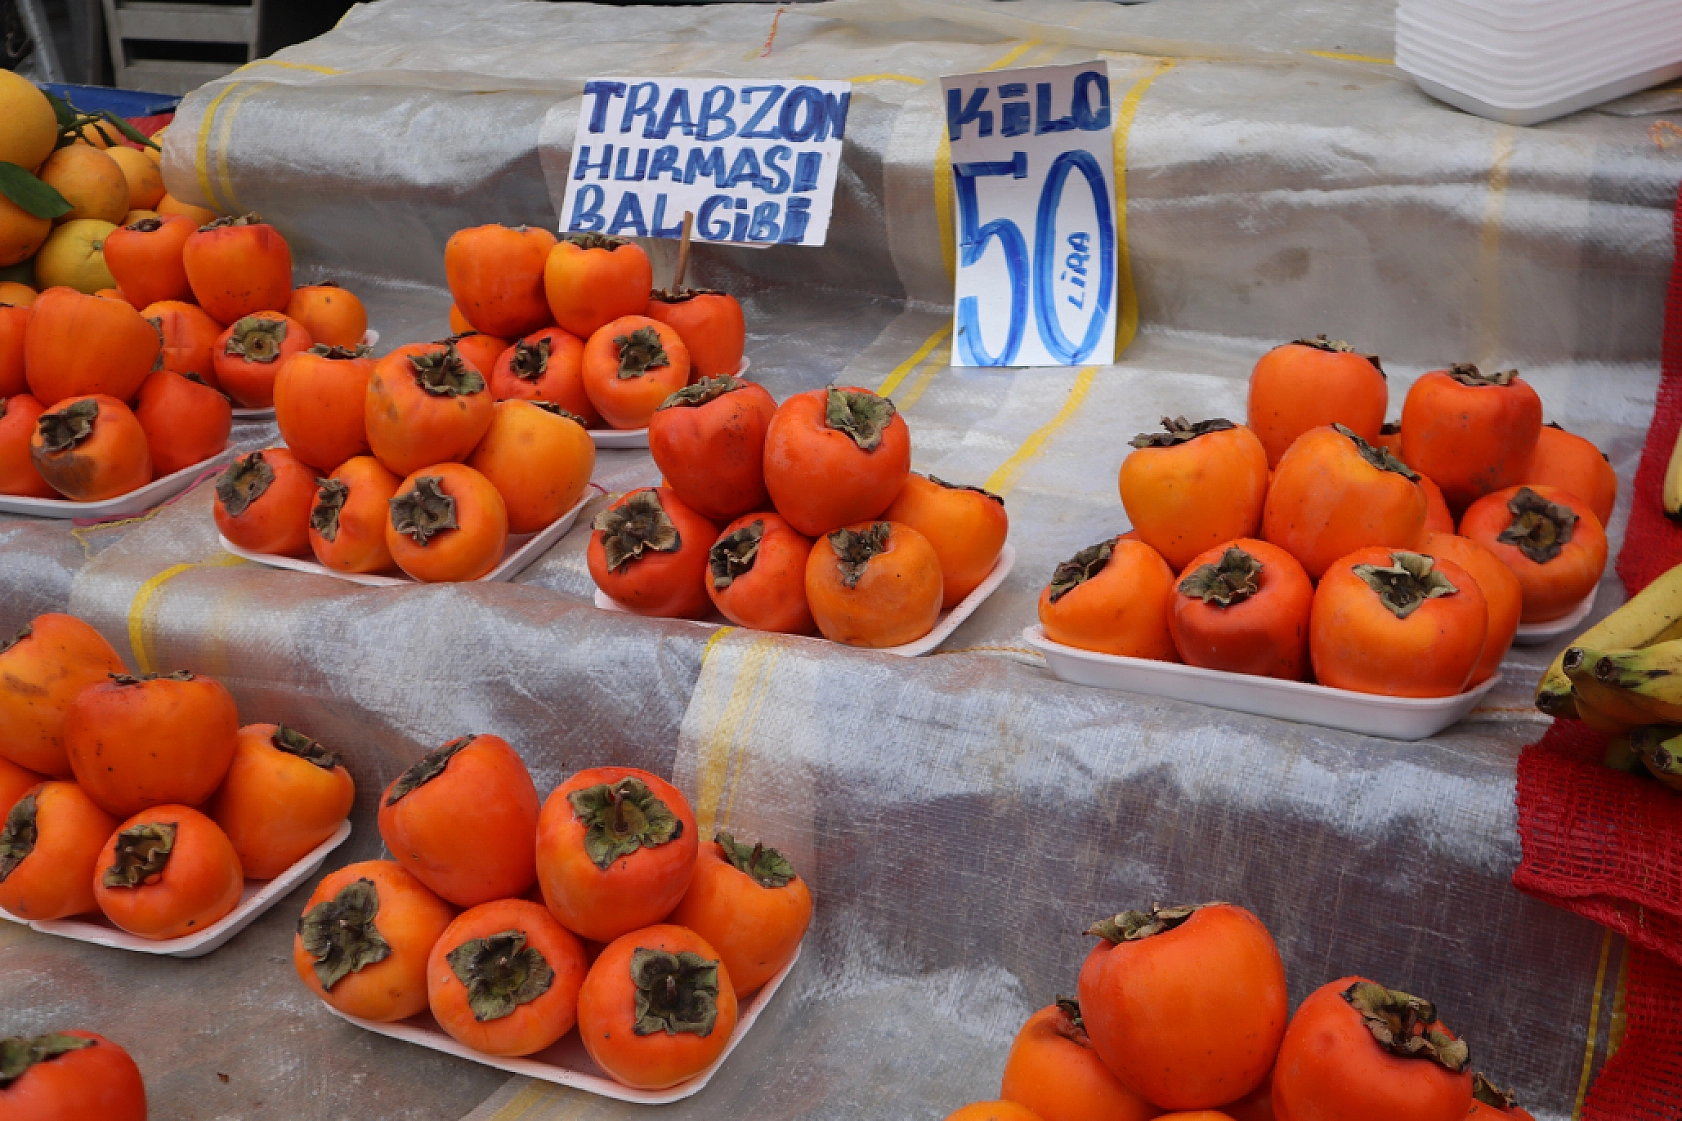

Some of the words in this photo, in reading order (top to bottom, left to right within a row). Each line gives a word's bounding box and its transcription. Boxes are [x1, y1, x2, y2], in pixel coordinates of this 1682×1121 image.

[583, 81, 852, 143] TRABZON
[573, 143, 822, 194] HURMASI
[568, 184, 690, 238] BAL
[952, 149, 1114, 367] 50
